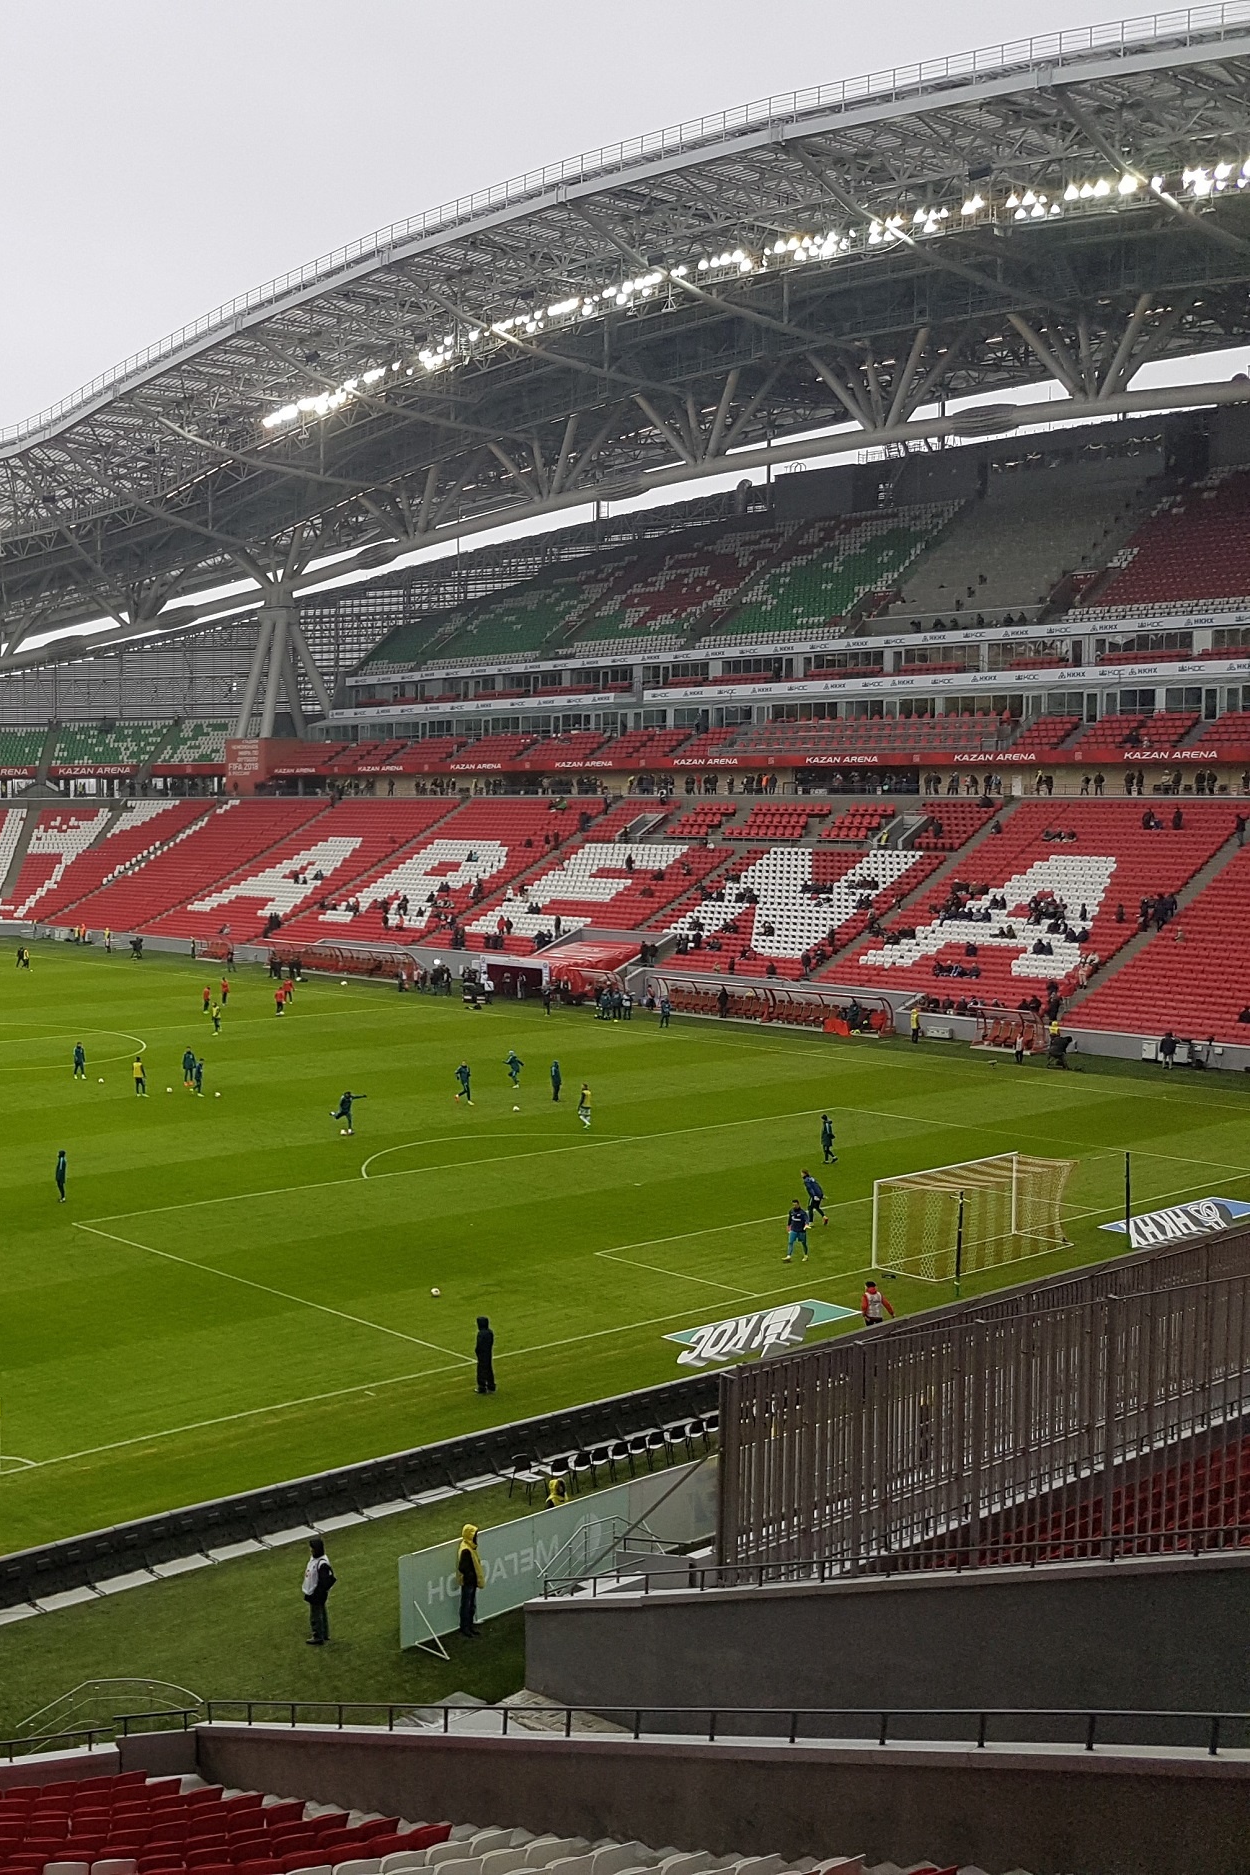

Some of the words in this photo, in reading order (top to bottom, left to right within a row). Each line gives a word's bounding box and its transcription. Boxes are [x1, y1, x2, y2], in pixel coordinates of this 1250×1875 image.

[954, 754, 993, 762] KAZAN
[996, 753, 1036, 761] ARENA
[1124, 751, 1167, 759] KAZAN
[1171, 750, 1218, 759] ARENA
[58, 767, 93, 775] KAZAN
[97, 767, 131, 775] ARENA
[187, 836, 1116, 980] ARENA
